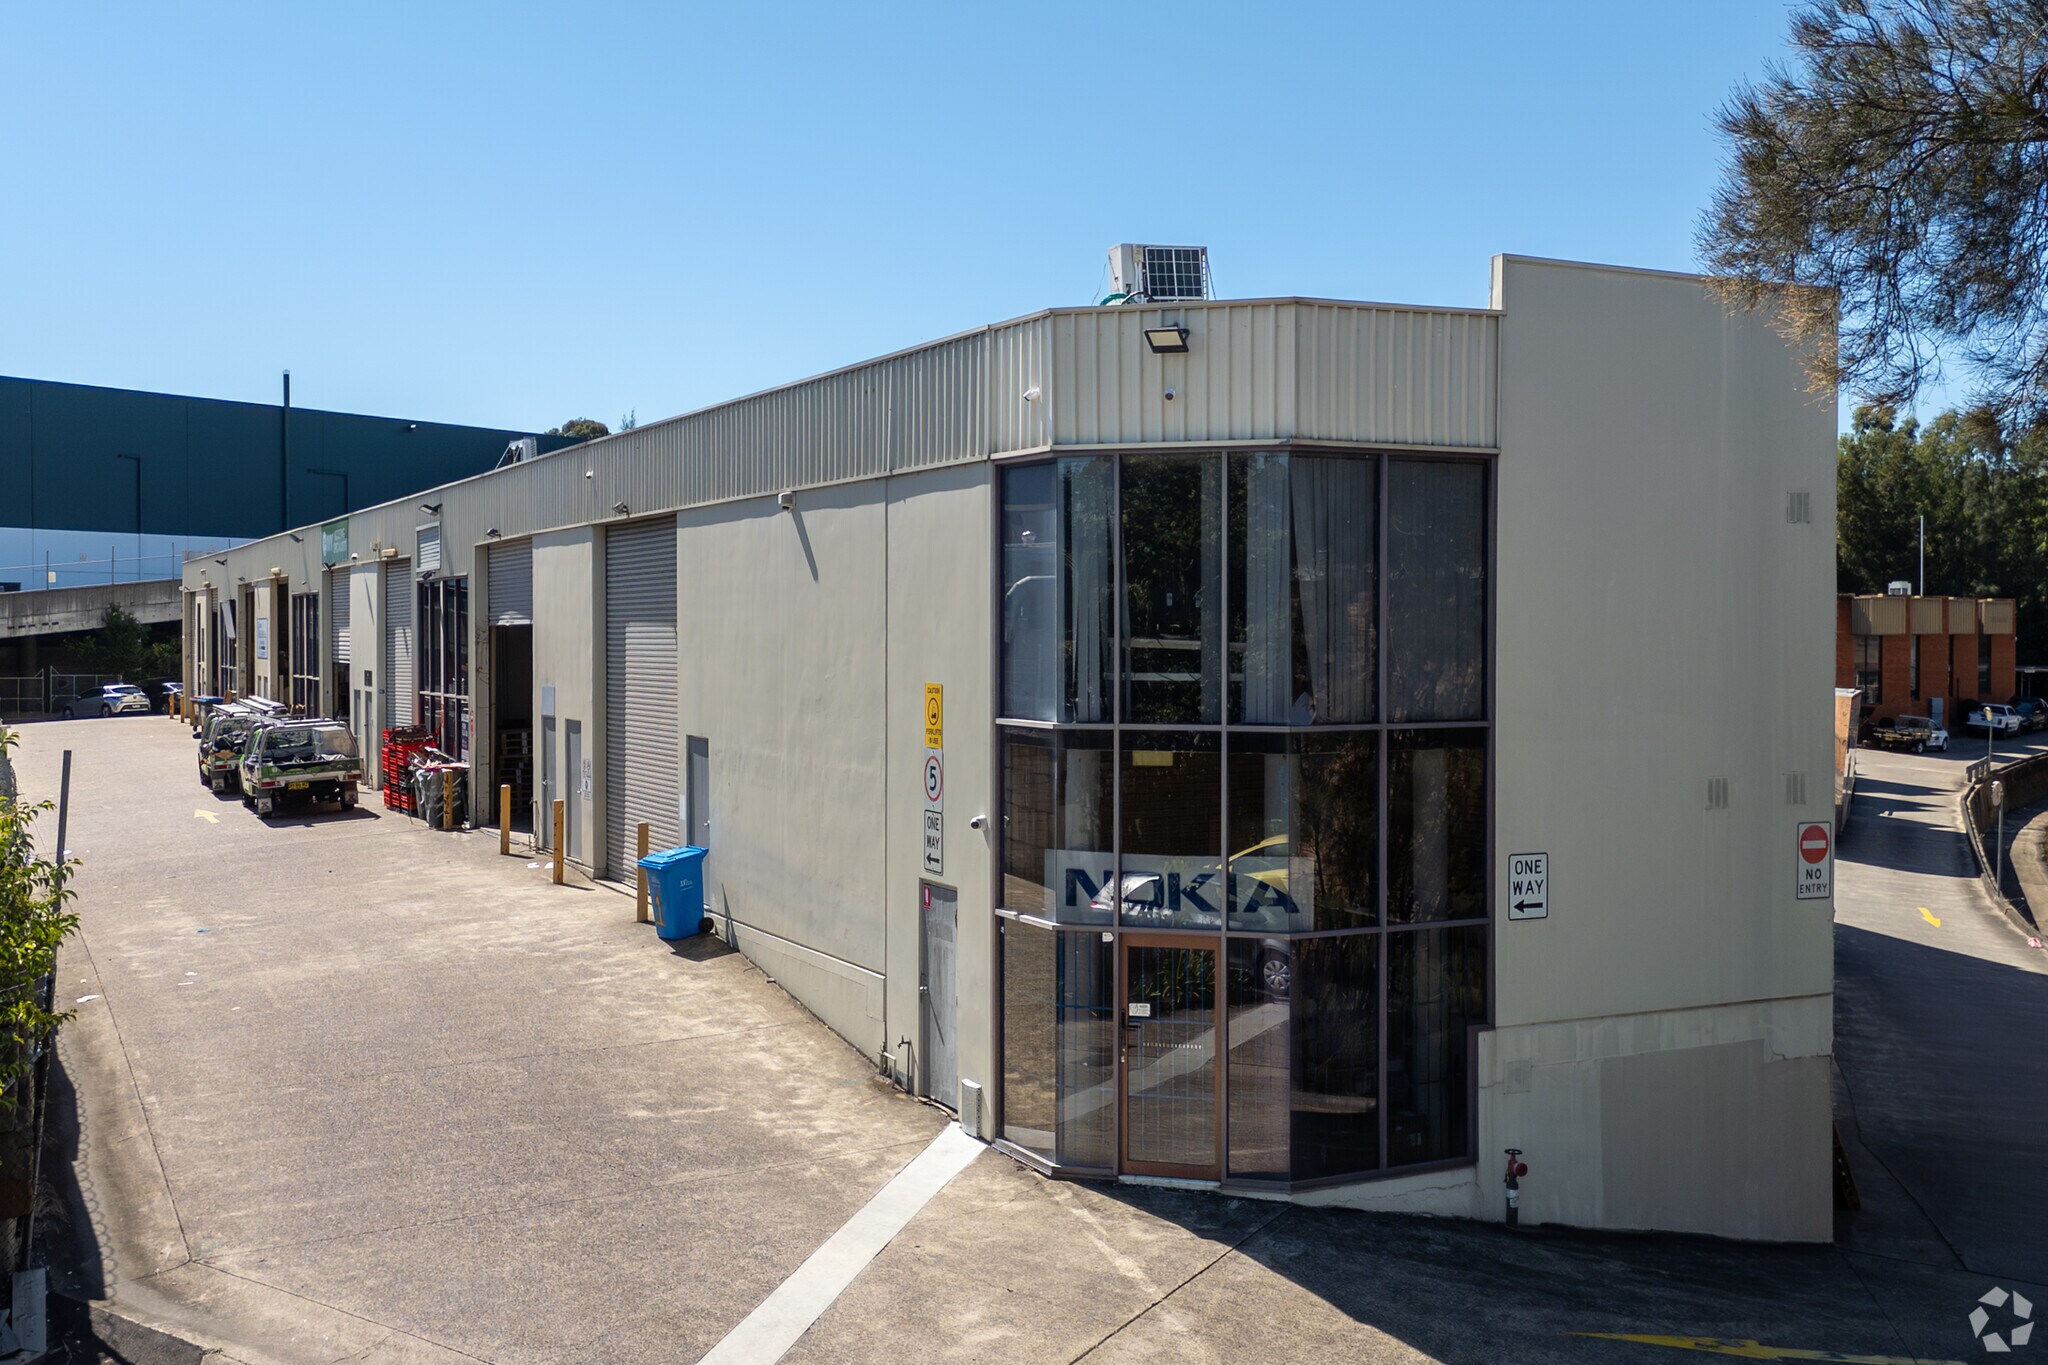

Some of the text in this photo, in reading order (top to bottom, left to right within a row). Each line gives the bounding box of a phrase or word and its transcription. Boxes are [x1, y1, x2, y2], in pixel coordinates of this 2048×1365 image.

[930, 766, 937, 791] 5
[927, 816, 940, 831] ONE
[926, 835, 940, 850] WAY
[1515, 859, 1542, 875] ONE
[1806, 868, 1822, 880] NO
[1513, 879, 1544, 896] WAY
[1800, 883, 1828, 894] ENTRY
